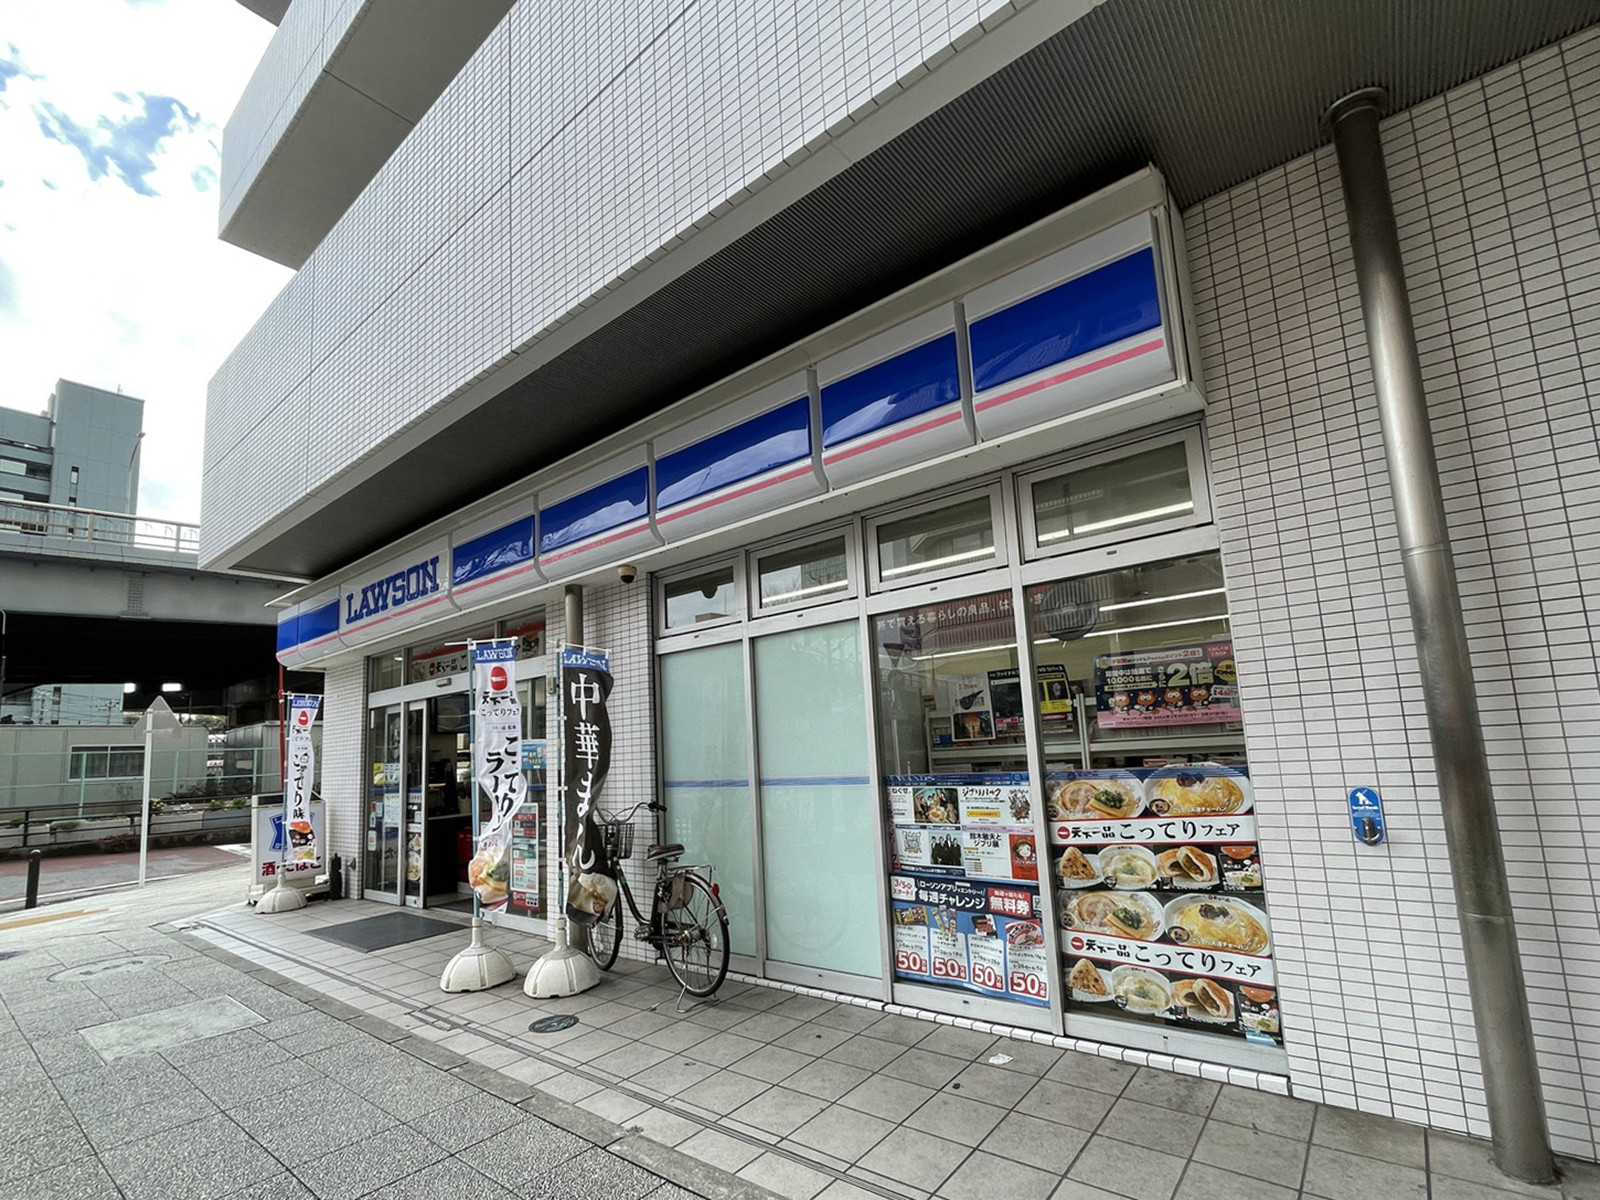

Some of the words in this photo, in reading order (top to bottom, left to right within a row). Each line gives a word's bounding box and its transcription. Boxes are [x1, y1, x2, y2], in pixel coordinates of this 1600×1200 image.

[346, 555, 439, 624] LAWSON
[476, 646, 513, 660] LAWSON
[563, 652, 607, 670] LAWN
[1166, 660, 1215, 687] 2倍
[292, 699, 319, 709] LSON
[571, 672, 599, 871] 中華まん
[1071, 826, 1116, 839] 天下一品
[1119, 820, 1241, 840] こってりフェア
[918, 889, 985, 910] 毎週チャレンジ
[990, 896, 1030, 915] 無料券
[1085, 938, 1131, 958] 天下一品
[1134, 944, 1263, 978] こってりフェア
